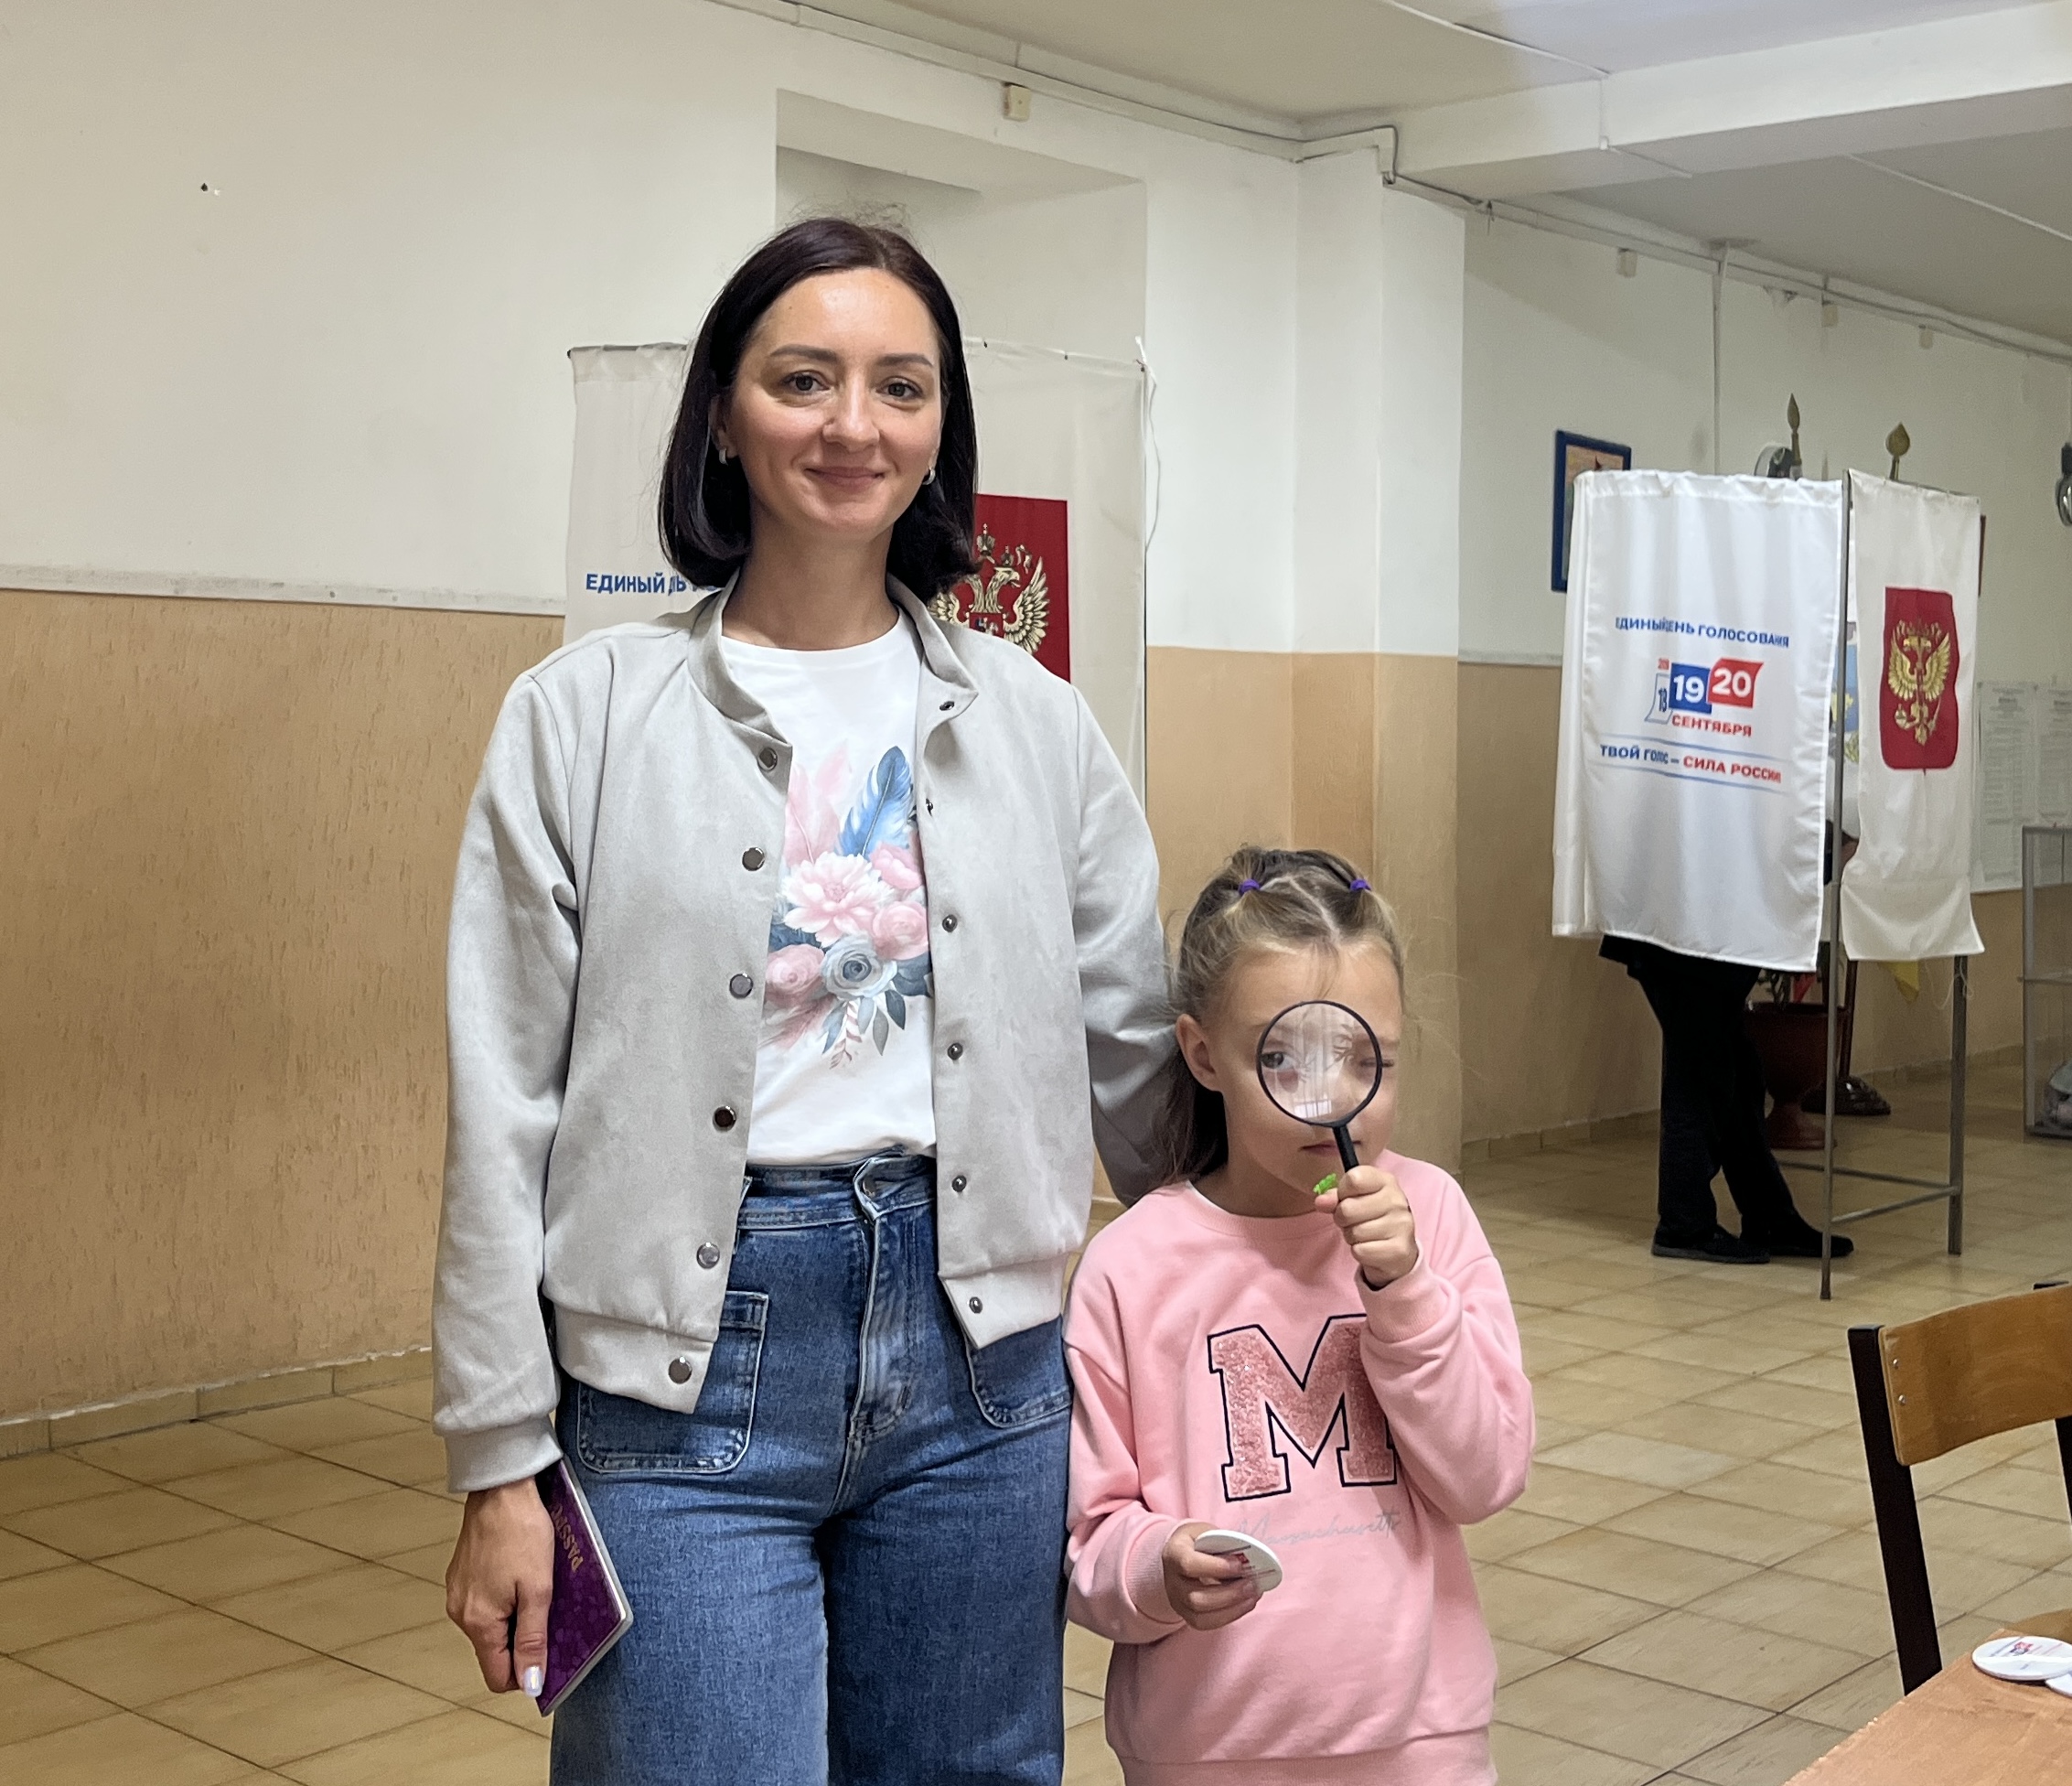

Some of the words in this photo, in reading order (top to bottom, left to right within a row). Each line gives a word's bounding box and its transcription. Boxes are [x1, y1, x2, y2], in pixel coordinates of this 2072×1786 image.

[585, 572, 665, 594] ЕДИНЫЙ
[1673, 674, 1705, 703] 19
[1712, 667, 1752, 697] 20
[1671, 715, 1752, 737] СЕНТЯБРЯ
[1599, 744, 1639, 760] ТВОЙ
[1683, 755, 1726, 774] СИЛА
[1207, 1313, 1399, 1502] M
